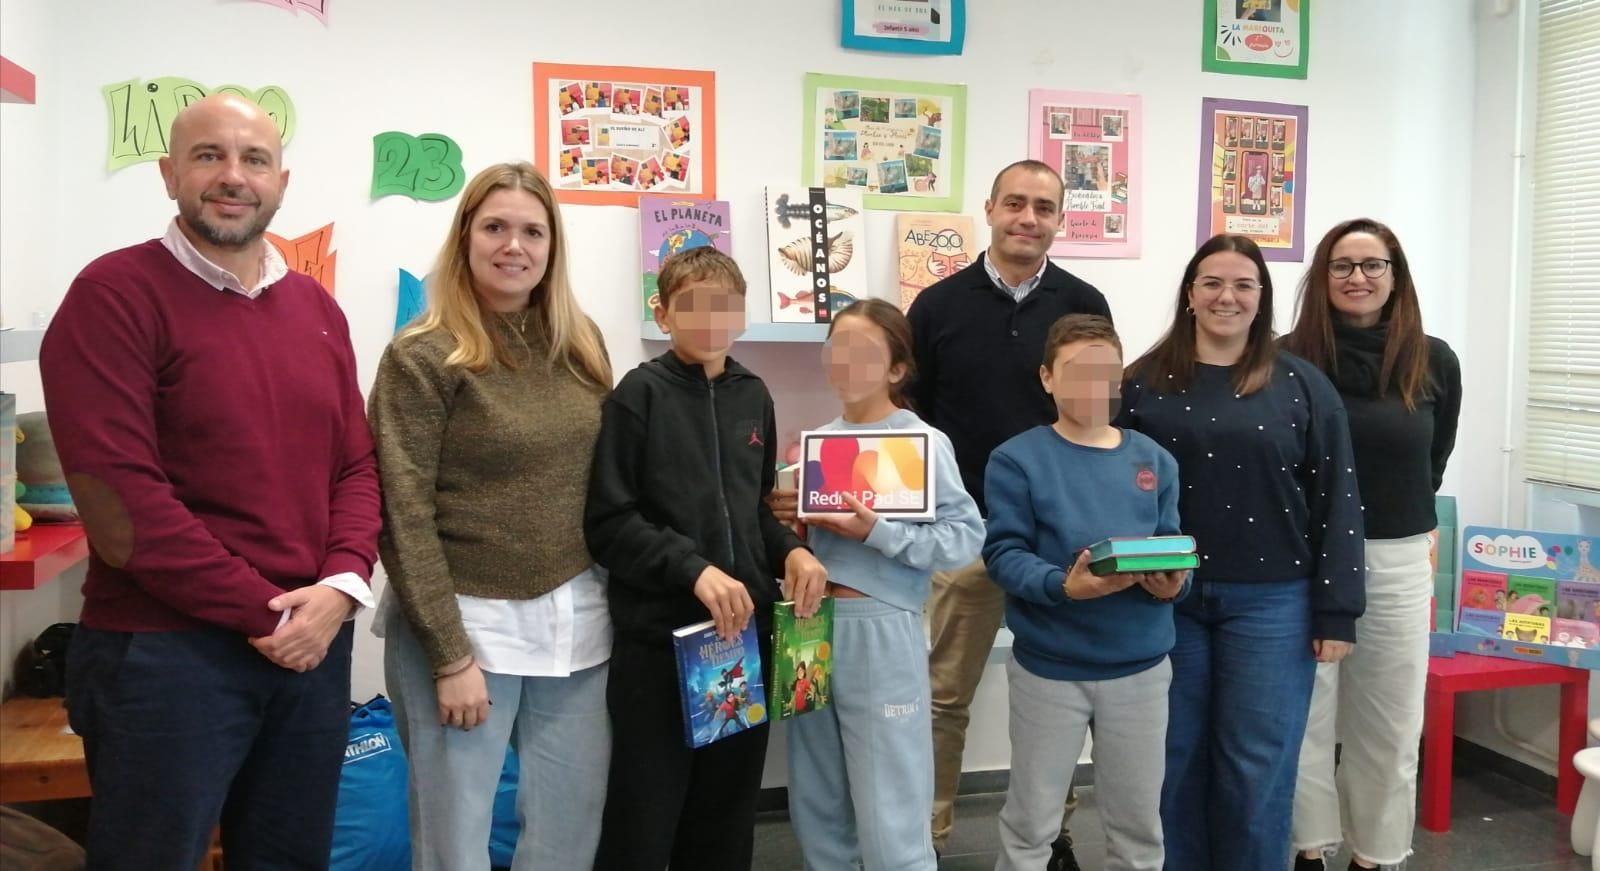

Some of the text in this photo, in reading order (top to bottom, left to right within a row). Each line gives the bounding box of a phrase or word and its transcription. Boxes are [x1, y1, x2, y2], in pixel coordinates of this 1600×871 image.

[1243, 24, 1285, 34] MARIQUITA
[377, 136, 456, 192] 23
[654, 207, 723, 228] EL PLANETA
[812, 203, 828, 303] OCÉANOS
[809, 490, 921, 506] Redi Pad SE
[1474, 542, 1537, 559] SOPHIE
